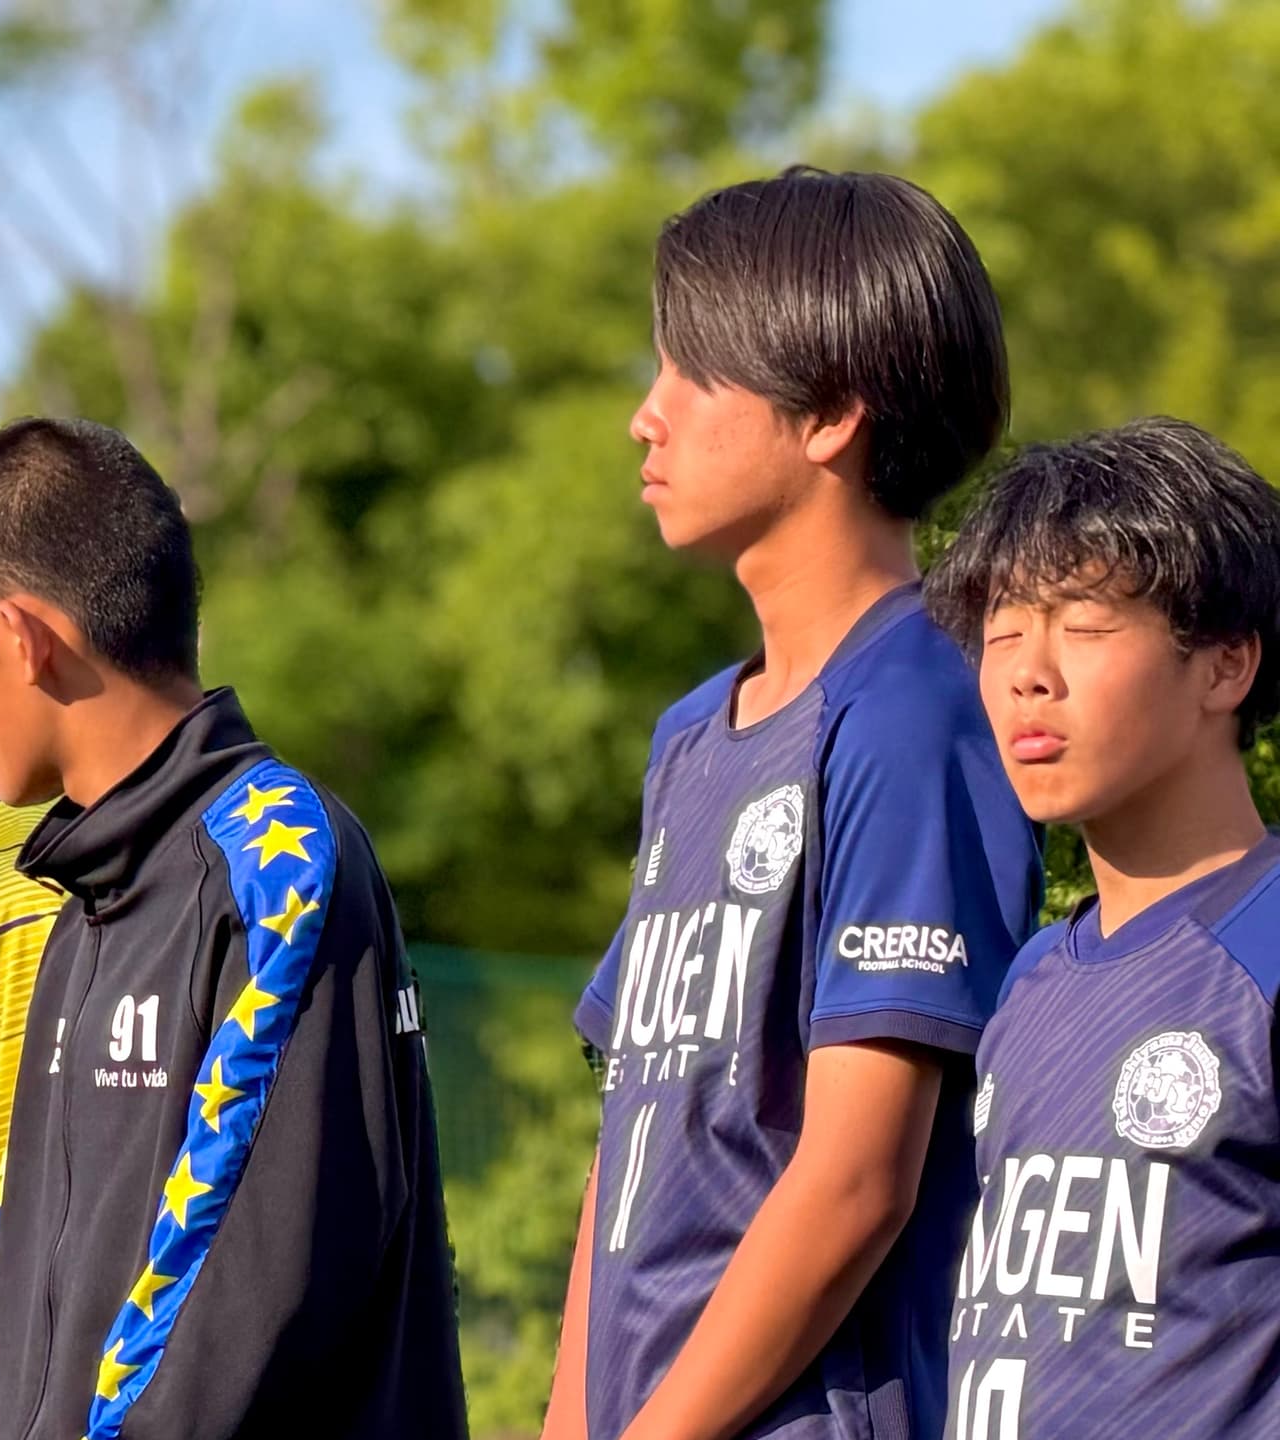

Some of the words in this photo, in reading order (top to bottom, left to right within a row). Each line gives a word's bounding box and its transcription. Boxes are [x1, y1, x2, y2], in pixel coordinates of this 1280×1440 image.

[838, 925, 969, 968] CRERISA
[901, 958, 946, 975] SCHOOL
[108, 994, 160, 1062] 91
[94, 1067, 119, 1088] Vive
[121, 1069, 138, 1088] tu
[142, 1067, 169, 1088] vida
[958, 1153, 1170, 1305] UGEN
